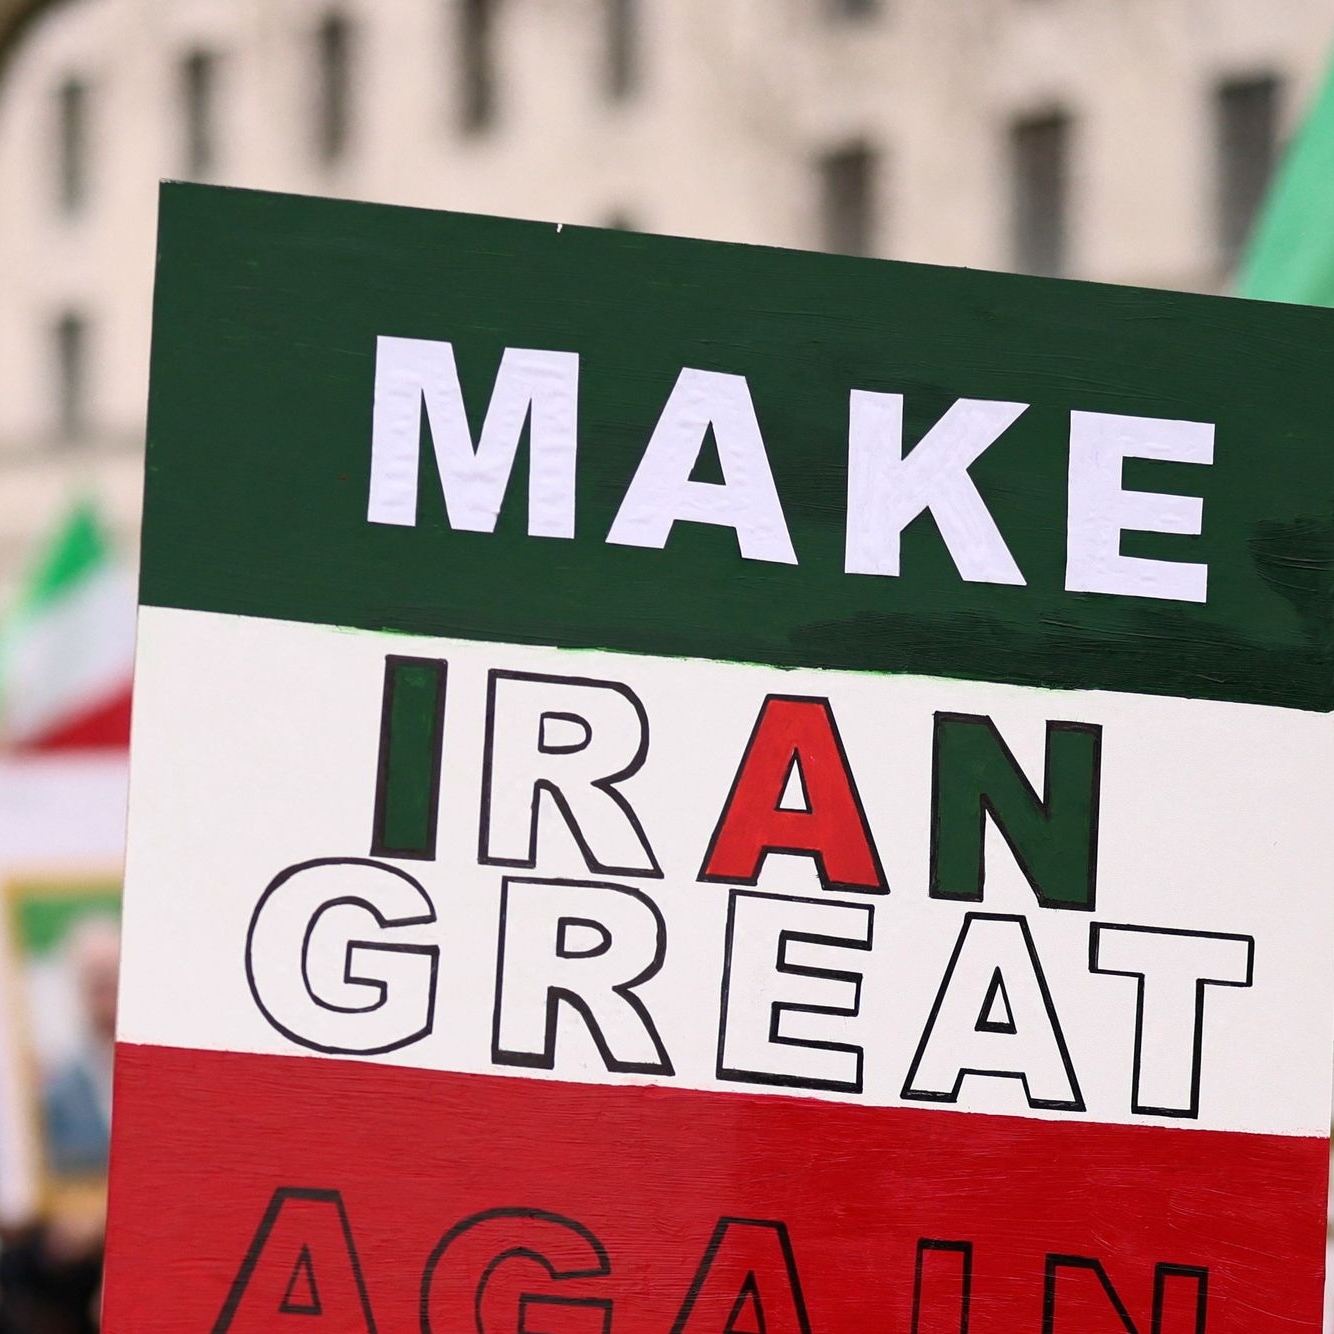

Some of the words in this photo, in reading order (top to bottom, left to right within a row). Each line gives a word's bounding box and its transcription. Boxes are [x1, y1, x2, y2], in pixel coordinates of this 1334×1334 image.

[367, 335, 1216, 604] MAKE
[369, 653, 1104, 911] IRAN
[244, 856, 1255, 1119] GREAT
